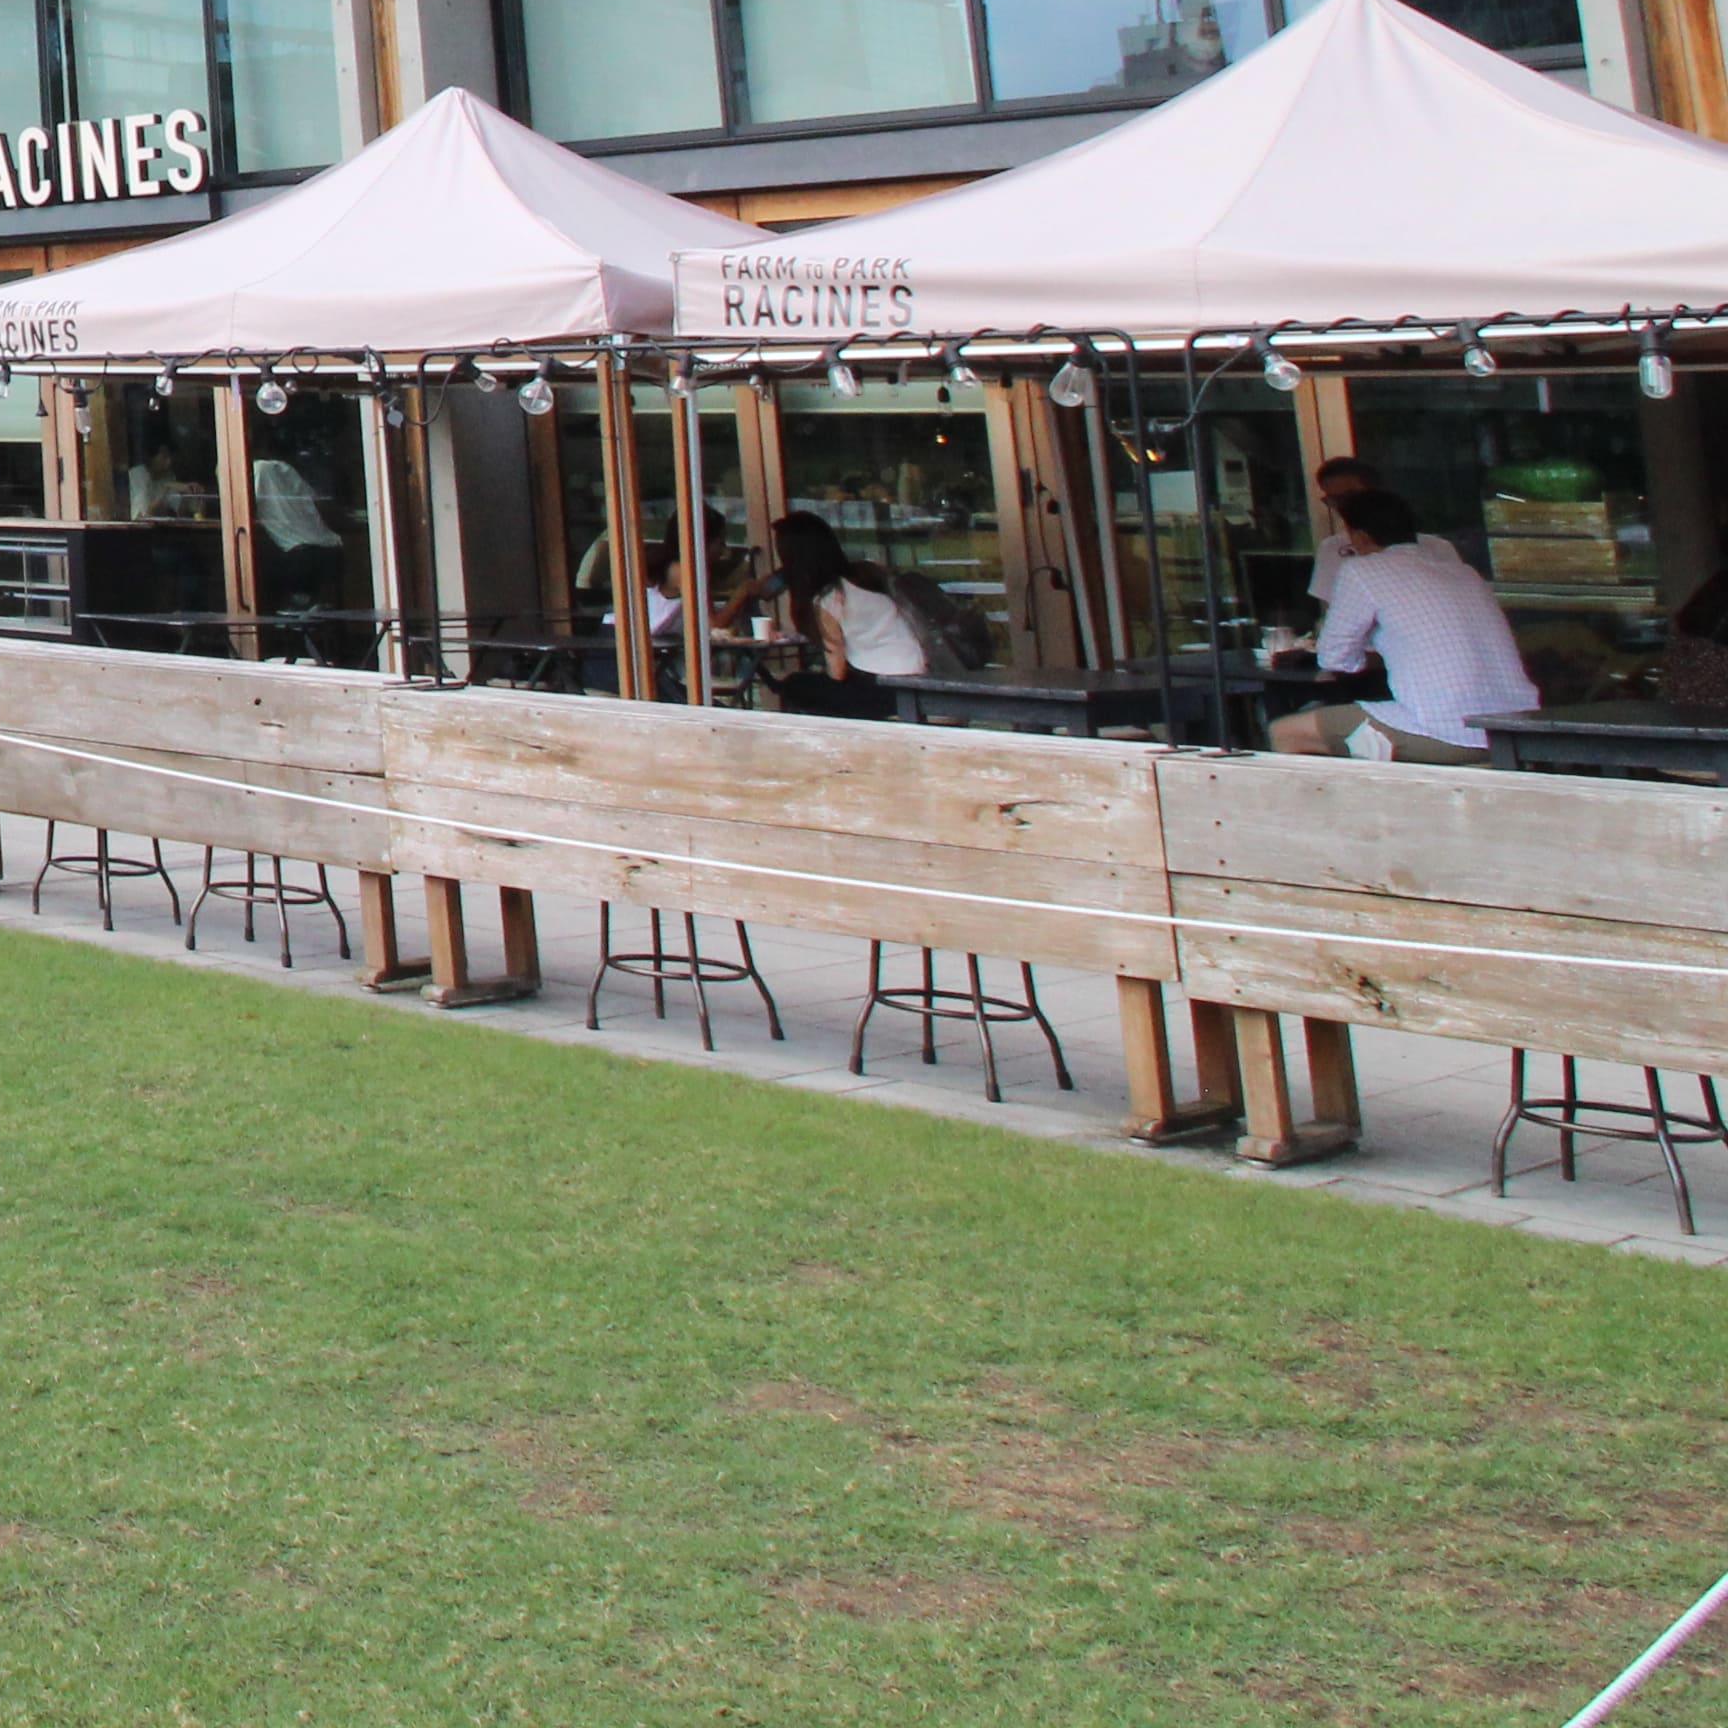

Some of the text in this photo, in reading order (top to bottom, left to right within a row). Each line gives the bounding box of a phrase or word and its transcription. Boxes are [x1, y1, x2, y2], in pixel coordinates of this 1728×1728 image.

[721, 255, 797, 280] FARM
[832, 257, 912, 280] PARK
[35, 299, 83, 316] PARK
[723, 284, 913, 327] RACINES
